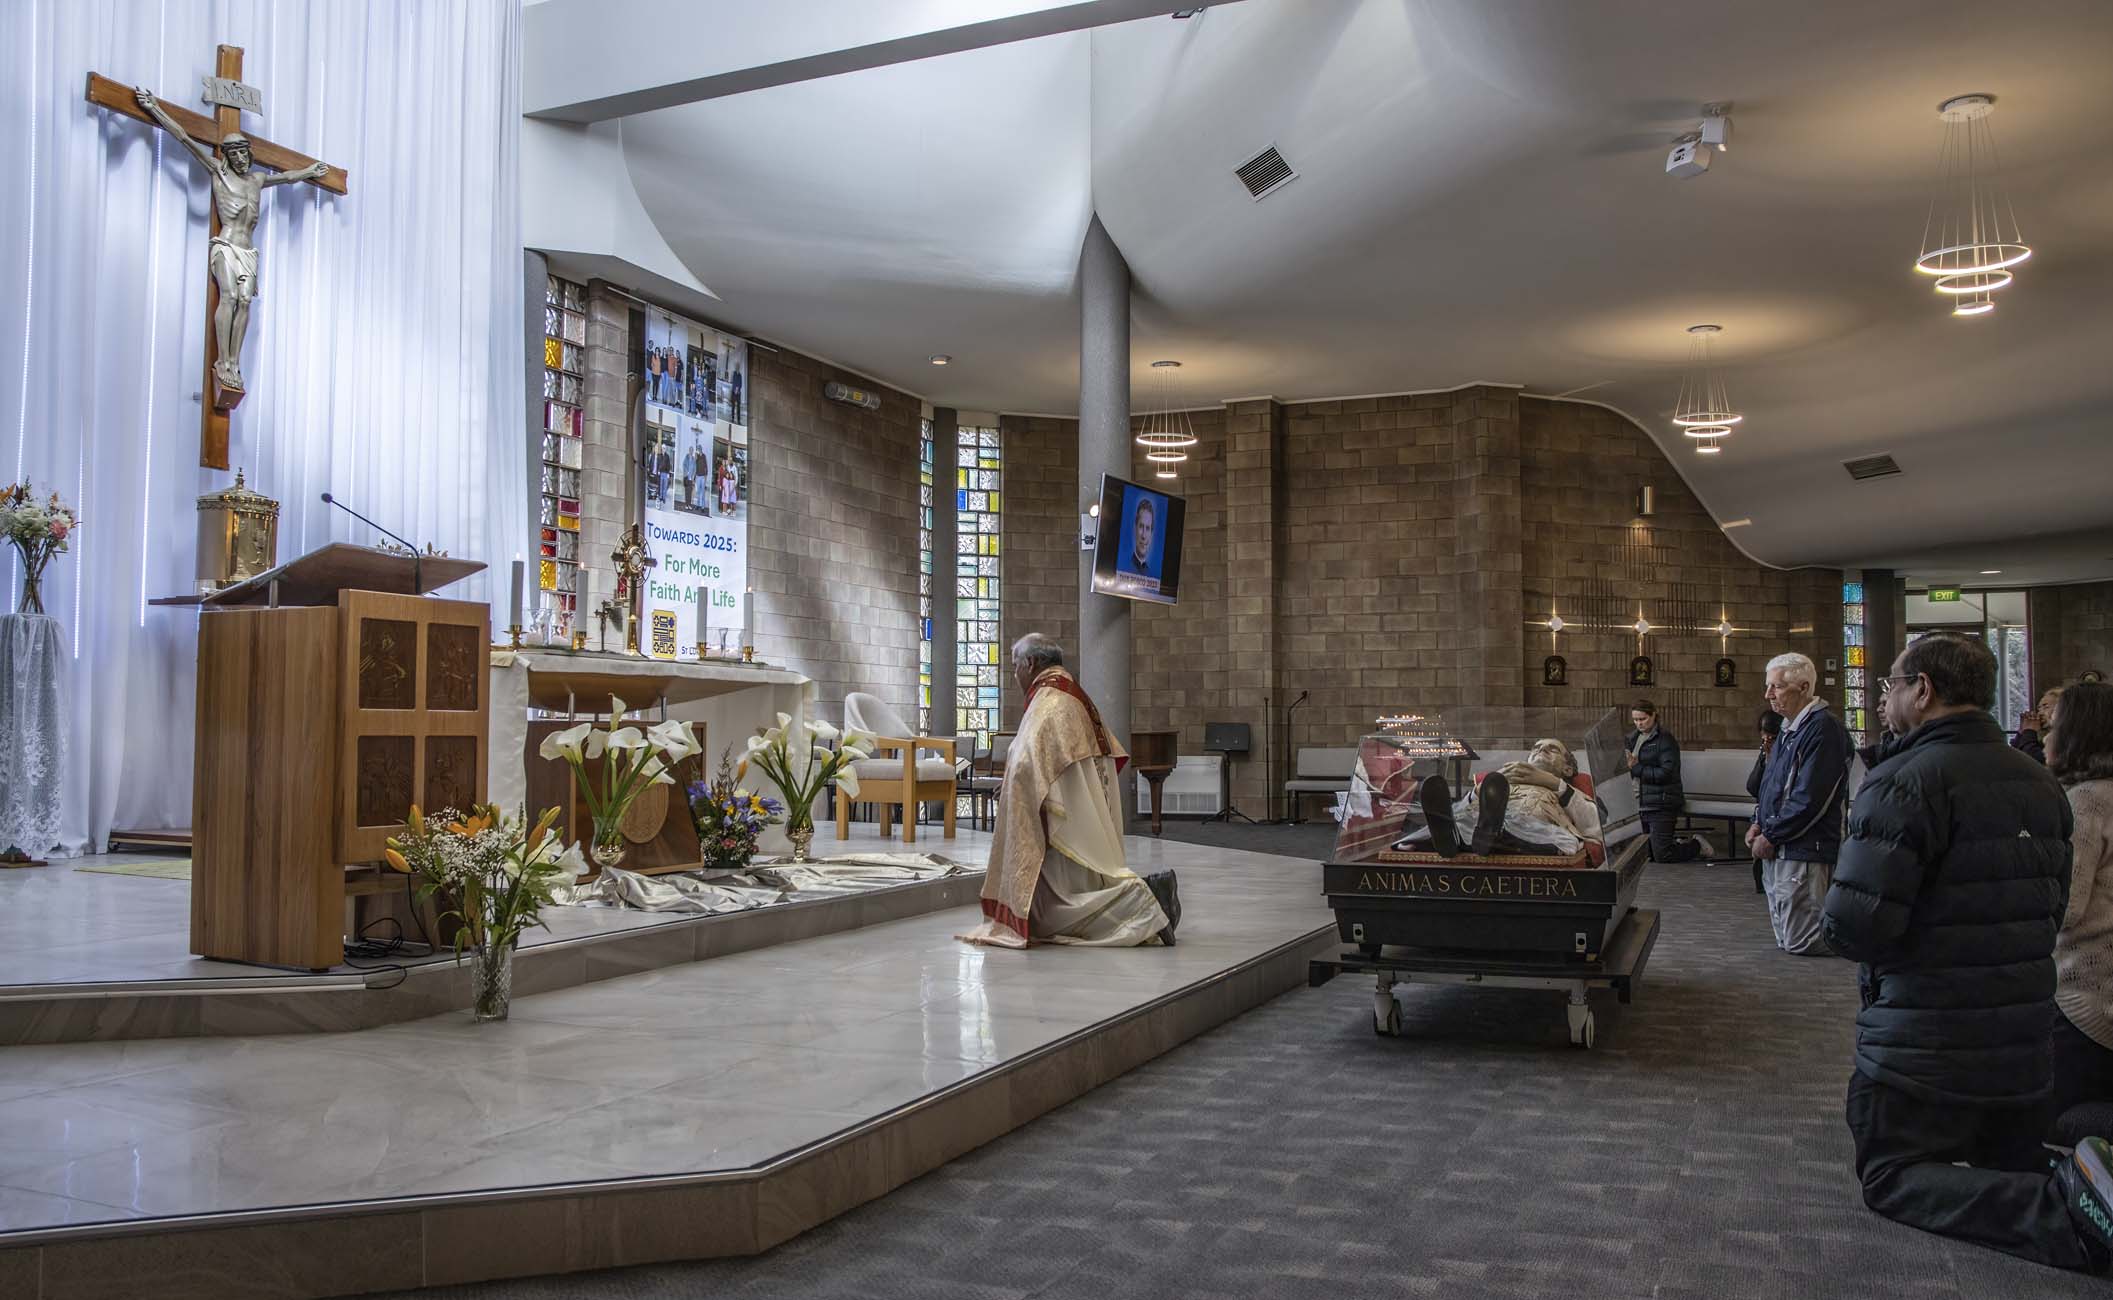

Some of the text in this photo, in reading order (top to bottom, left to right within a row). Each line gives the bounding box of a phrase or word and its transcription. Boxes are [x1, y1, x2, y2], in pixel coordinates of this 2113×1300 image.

[703, 534, 737, 552] 2025:
[665, 553, 720, 579] For More
[650, 580, 736, 608] Faith An Life
[1935, 591, 1954, 601] EXIT
[1357, 871, 1577, 897] ANIMAS CAETERA
